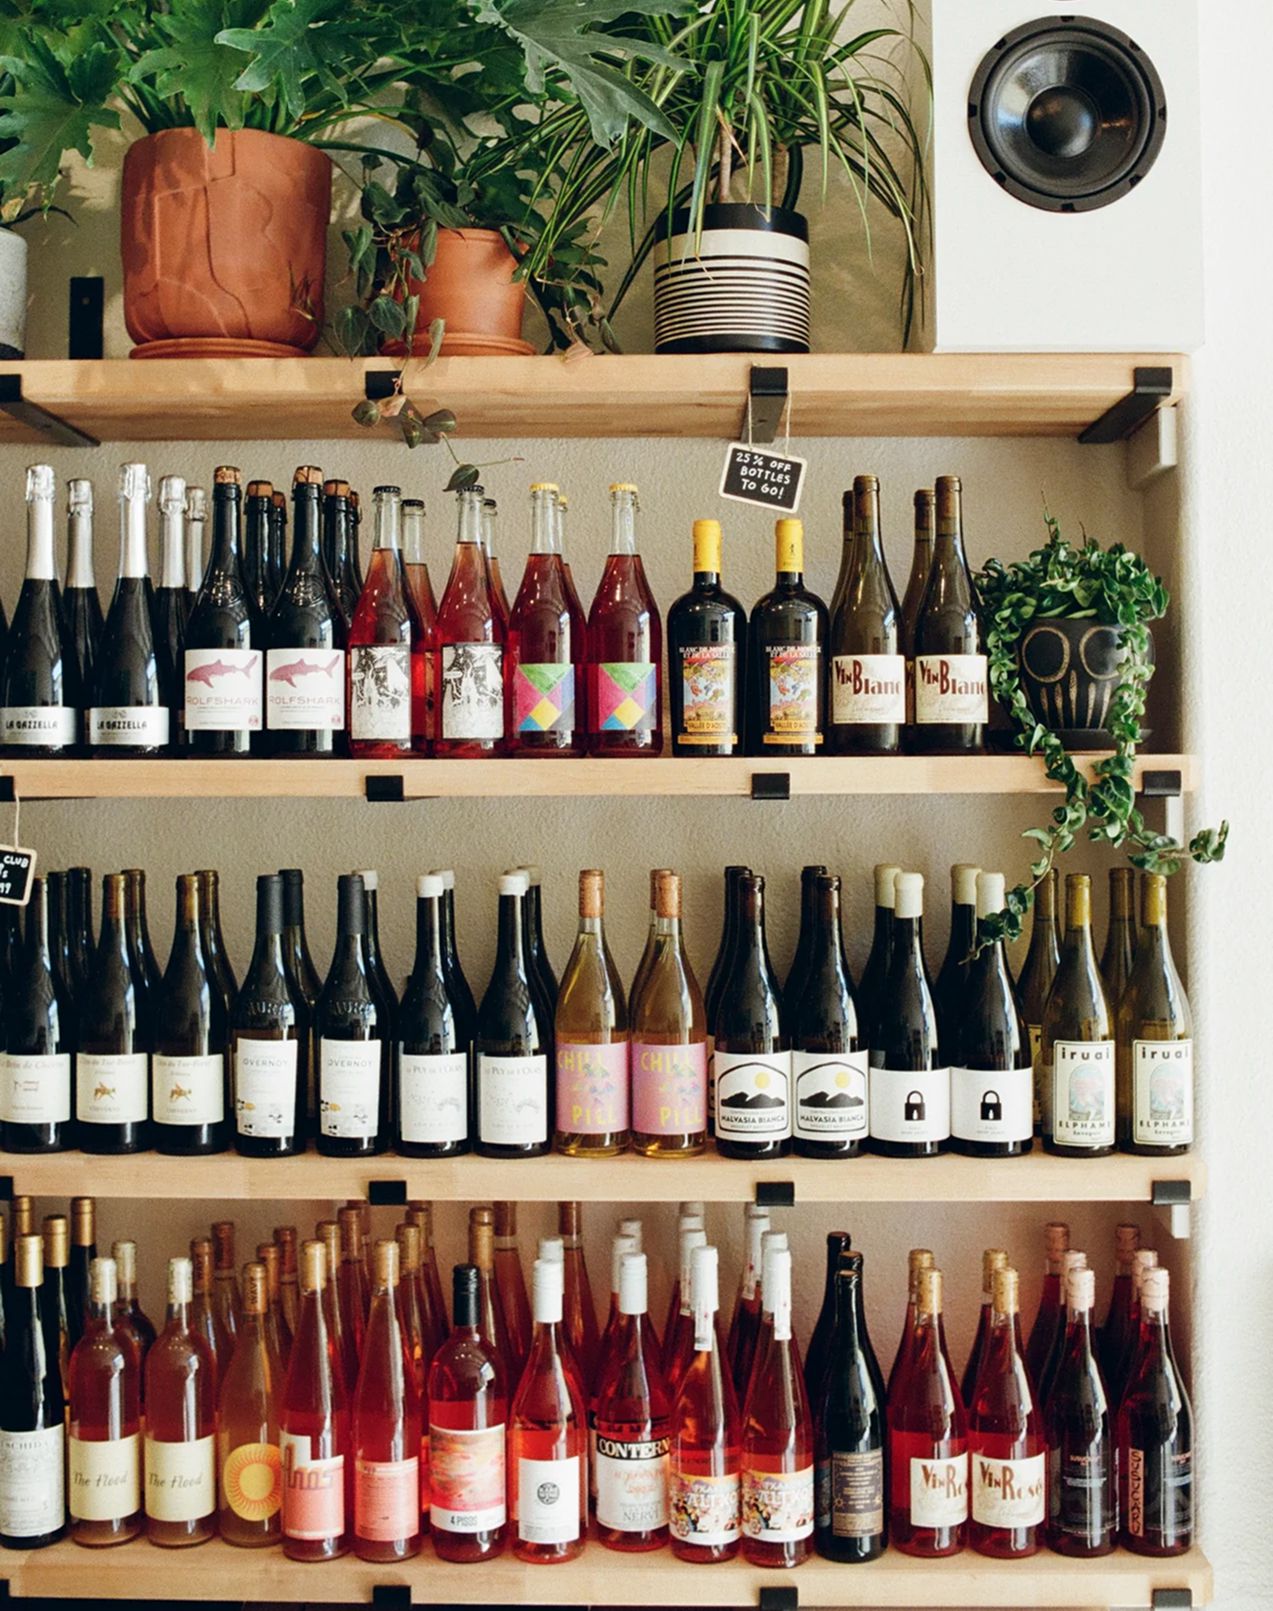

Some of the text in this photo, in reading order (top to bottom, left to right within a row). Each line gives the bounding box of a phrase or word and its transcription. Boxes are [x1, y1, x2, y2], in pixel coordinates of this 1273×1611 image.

[769, 461, 792, 473] OFF
[740, 466, 792, 485] BOTTLES
[741, 478, 785, 500] TO GO!
[6, 720, 14, 729] LA
[3, 855, 29, 869] CLUB
[721, 1115, 785, 1124] MALVASIA BIANCA
[800, 1114, 864, 1124] MALVASIA BIANCA
[74, 1472, 90, 1487] The
[149, 1472, 166, 1487] The
